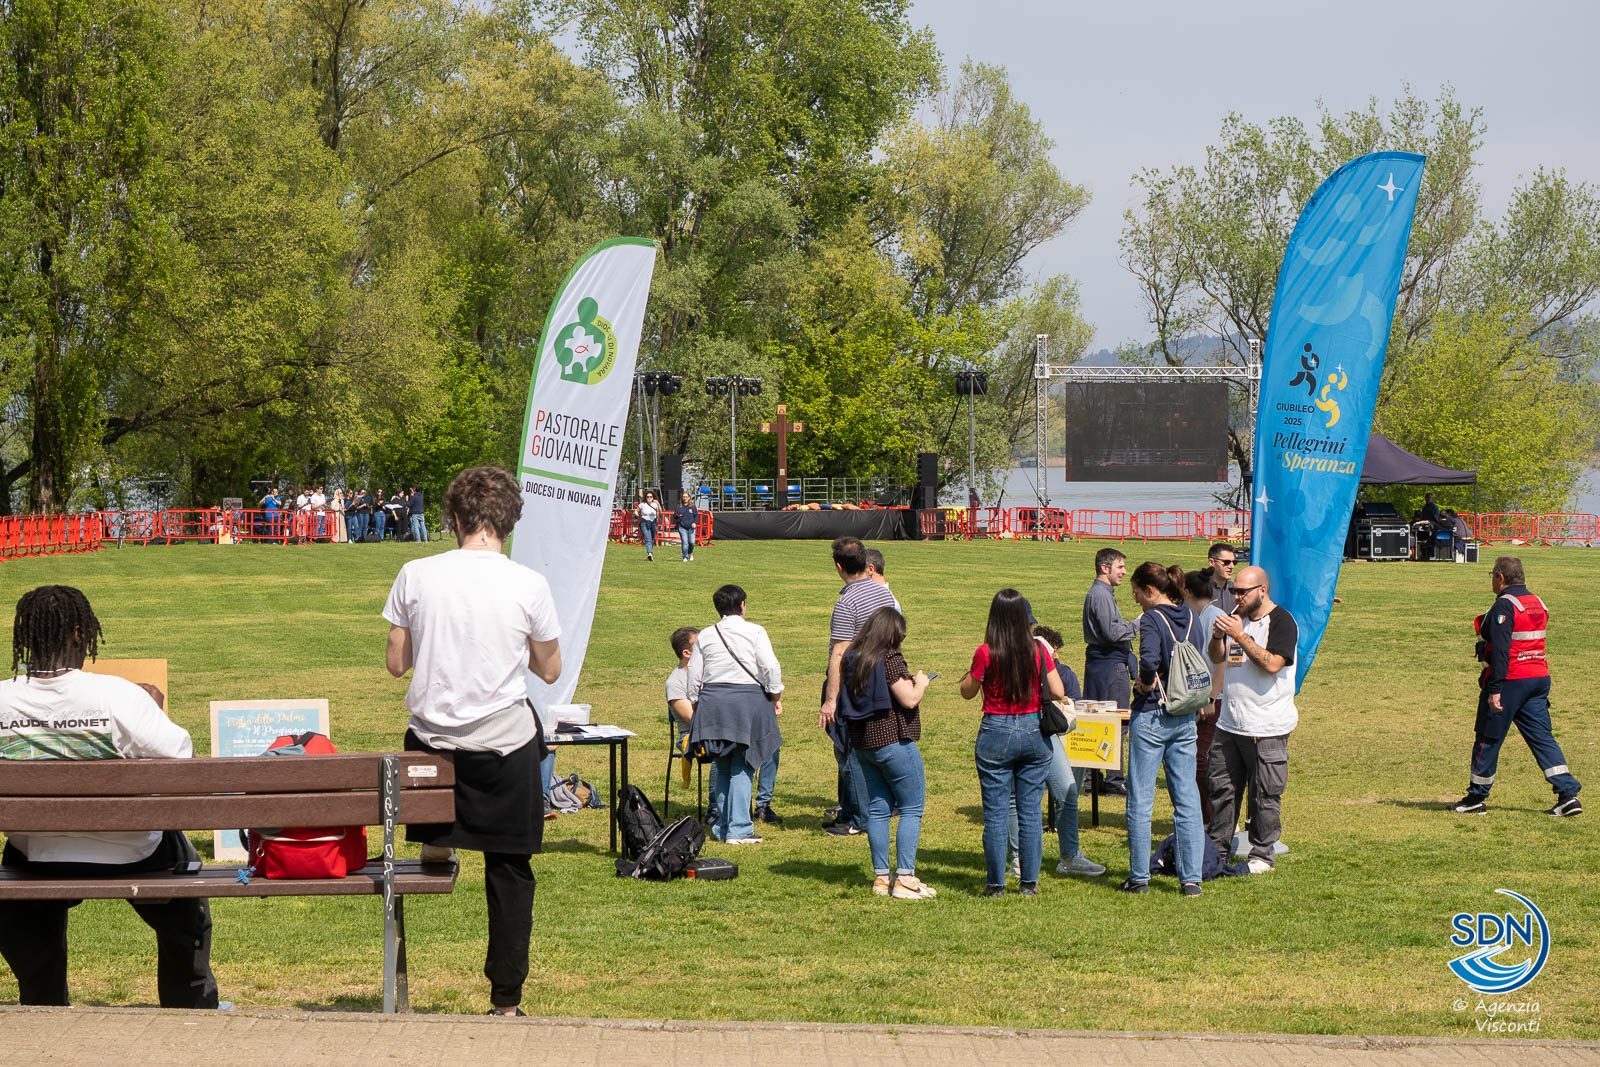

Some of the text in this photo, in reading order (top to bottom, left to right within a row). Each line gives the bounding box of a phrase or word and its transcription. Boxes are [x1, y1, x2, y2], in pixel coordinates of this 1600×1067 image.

[1276, 403, 1315, 414] GIUBILEO
[535, 409, 620, 447] PASTORALE
[1283, 417, 1302, 426] 2025
[531, 434, 608, 471] GIOVANILE
[1273, 431, 1348, 455] Pellegrini
[1281, 451, 1356, 474] Speranza
[525, 481, 602, 508] DIOCESI DI NOVARA
[0, 718, 110, 730] LAUDE MONET
